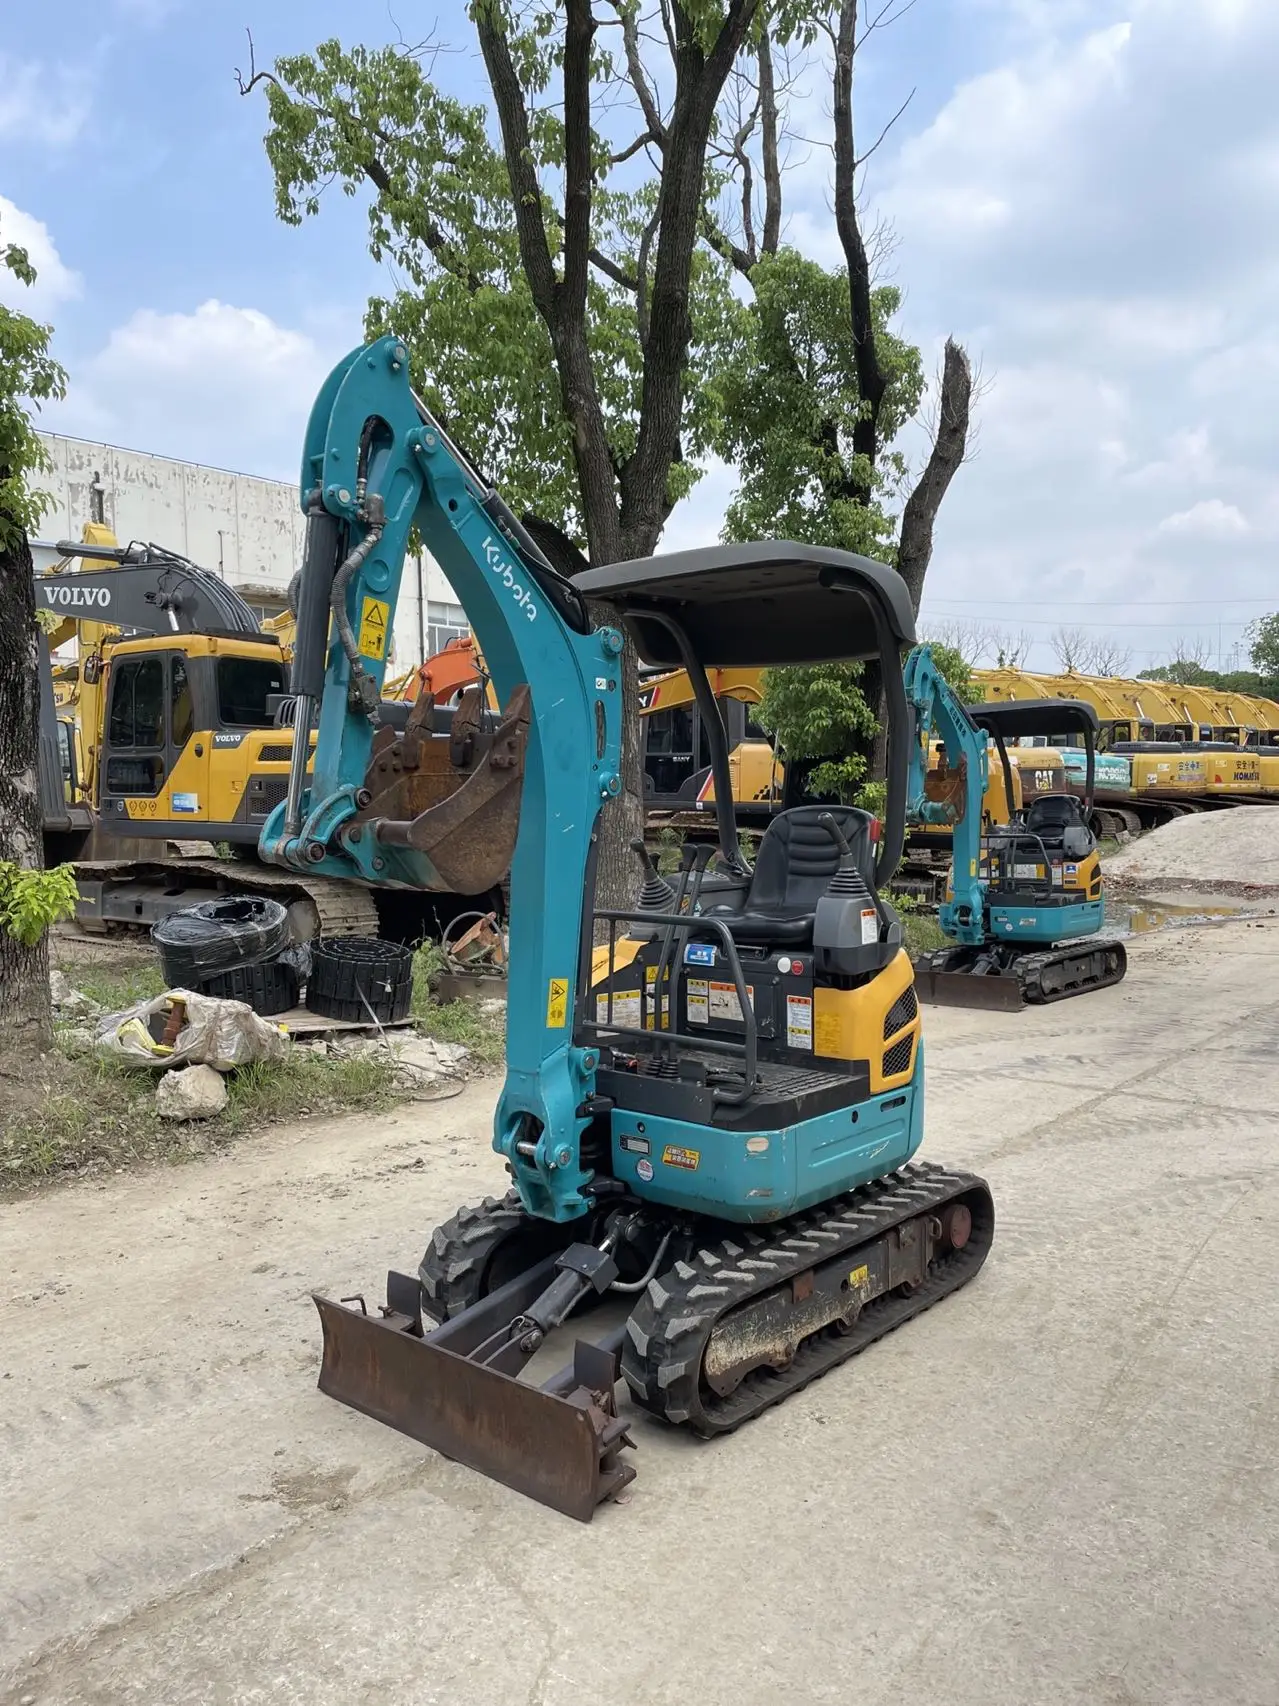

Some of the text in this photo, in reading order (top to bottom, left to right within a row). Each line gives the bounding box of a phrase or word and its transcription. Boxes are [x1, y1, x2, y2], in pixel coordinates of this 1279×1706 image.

[482, 536, 537, 622] Kubota
[44, 586, 111, 607] VOLVO
[1035, 770, 1054, 790] CAT
